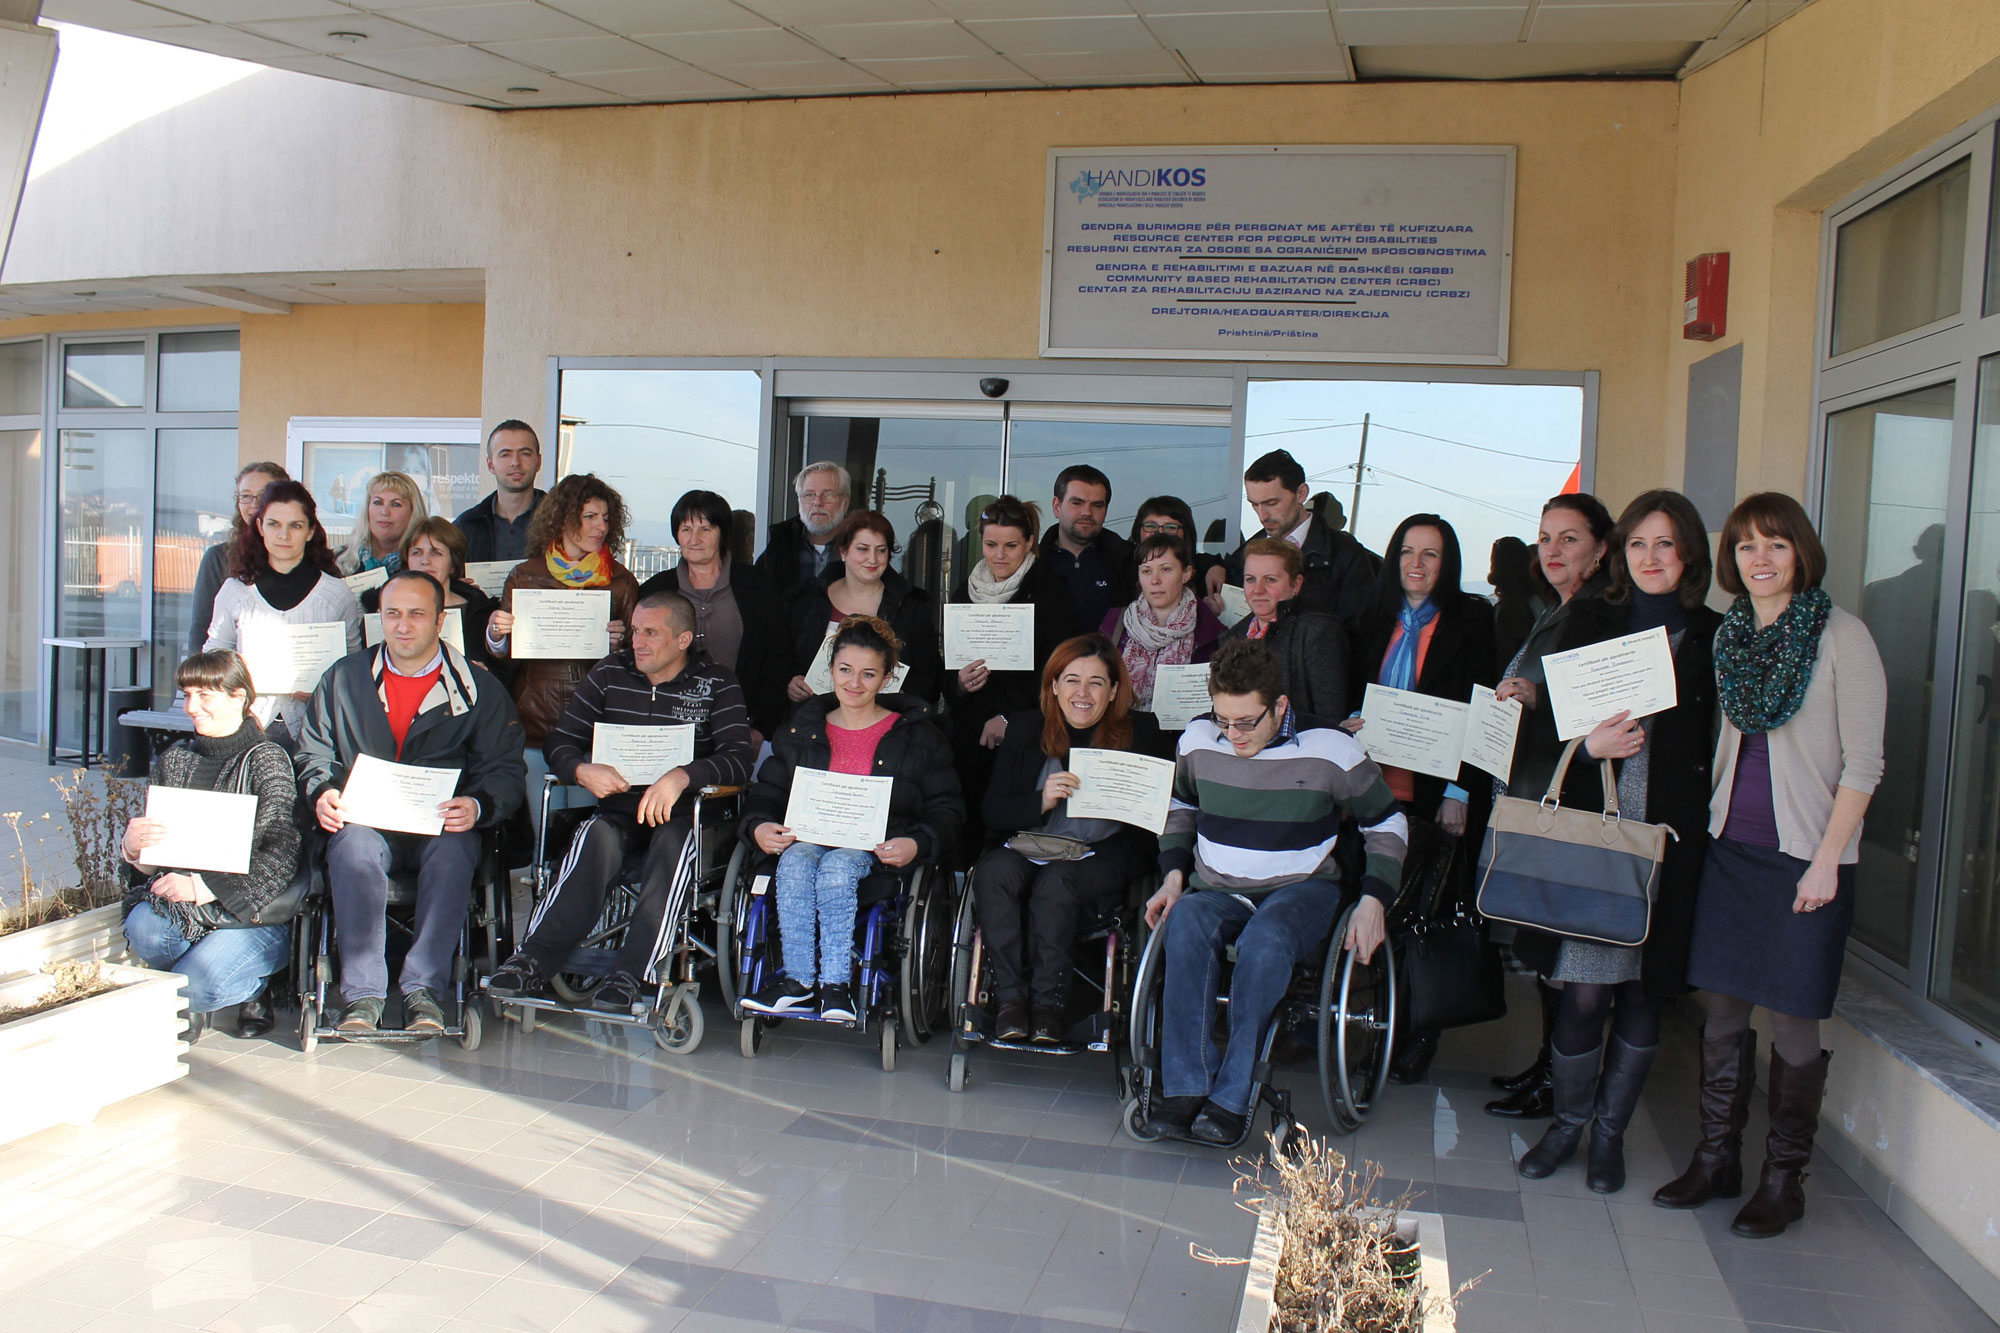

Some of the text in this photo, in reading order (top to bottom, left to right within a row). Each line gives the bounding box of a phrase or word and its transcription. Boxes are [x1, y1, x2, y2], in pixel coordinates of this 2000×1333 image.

[1087, 168, 1206, 187] HANDIKOS
[1081, 222, 1473, 233] QENDRA BURIMORE PËR PERSONAT ME AFTËSI TË KUFIZUARA
[1267, 235, 1315, 243] PEOPLE
[1356, 236, 1438, 244] DISABILITIES
[1207, 246, 1250, 254] OSOBE
[1372, 247, 1486, 256] SPOSOBNOSTIMA
[1163, 264, 1244, 272] REHABILITIMI
[1260, 265, 1312, 273] BAZUAR
[1317, 264, 1334, 273] NË
[1187, 275, 1230, 283] BASED
[1234, 276, 1336, 285] REHABILITATION
[1341, 277, 1391, 285] CENTER
[1152, 286, 1251, 294] REHABILITACIJU
[1255, 288, 1321, 296] BAZIRANO
[1349, 289, 1421, 297] ZAJEDNICU
